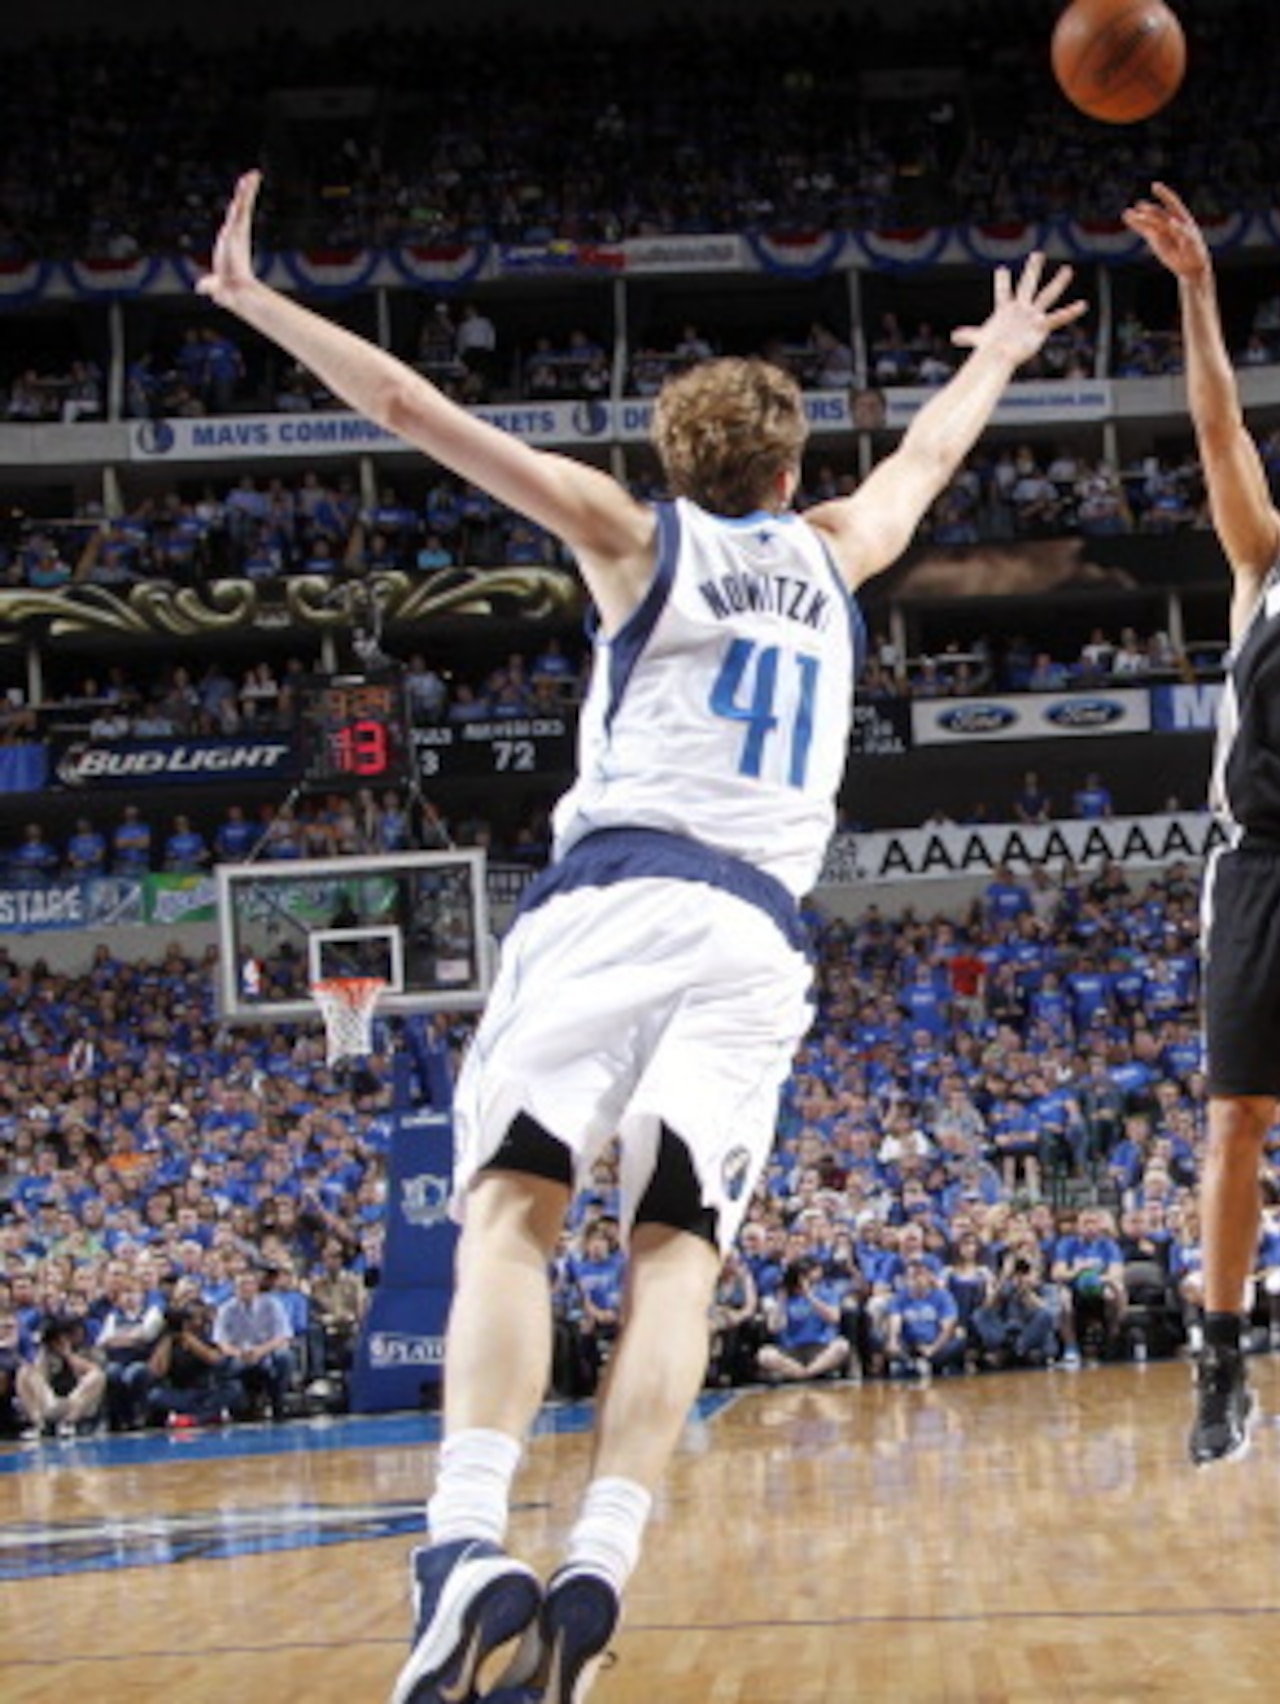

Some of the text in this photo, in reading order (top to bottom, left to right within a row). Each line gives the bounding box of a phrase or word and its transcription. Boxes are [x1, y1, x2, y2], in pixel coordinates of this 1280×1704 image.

[192, 422, 270, 446] MAVS
[708, 636, 820, 792] 41
[77, 745, 290, 777] BUD LIGHT
[419, 751, 440, 776] 3
[492, 740, 536, 771] 72
